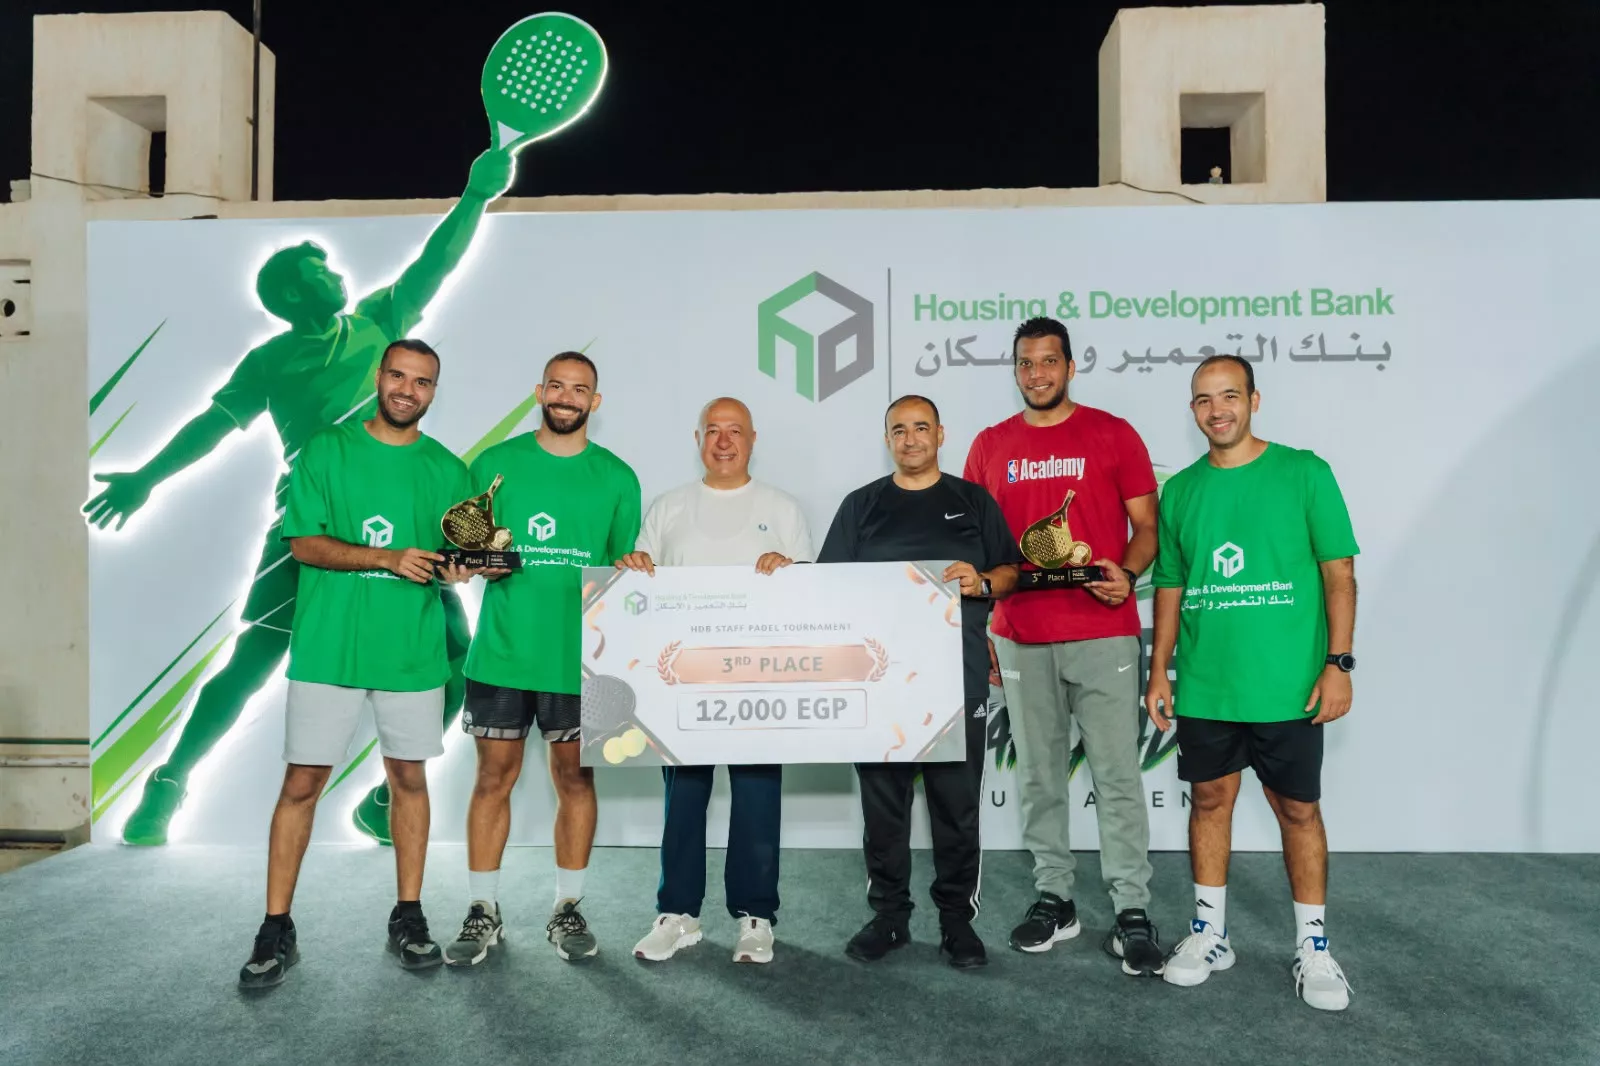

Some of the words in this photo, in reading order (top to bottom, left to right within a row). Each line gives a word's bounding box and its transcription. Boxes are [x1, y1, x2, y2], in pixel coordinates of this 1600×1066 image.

[914, 292, 1047, 321] Housing
[1056, 291, 1081, 319] &
[1089, 289, 1303, 325] Development
[1310, 287, 1395, 316] Bank
[1289, 331, 1392, 372] بنك
[1020, 455, 1086, 481] Academy
[524, 545, 572, 555] Developmen
[572, 548, 591, 558] Bank
[465, 557, 483, 565] Place
[1202, 585, 1209, 594] &
[1210, 583, 1271, 594] Development
[1215, 595, 1266, 610] التعمير
[1267, 594, 1295, 606] بنك
[690, 624, 712, 633] HDB
[715, 624, 745, 633] STAFF
[748, 624, 780, 632] PADEL
[783, 623, 851, 632] TOURNAMENT
[721, 655, 752, 673] 3RD
[759, 656, 823, 672] PLACE
[696, 698, 787, 726] 12,000
[797, 697, 848, 720] EGP
